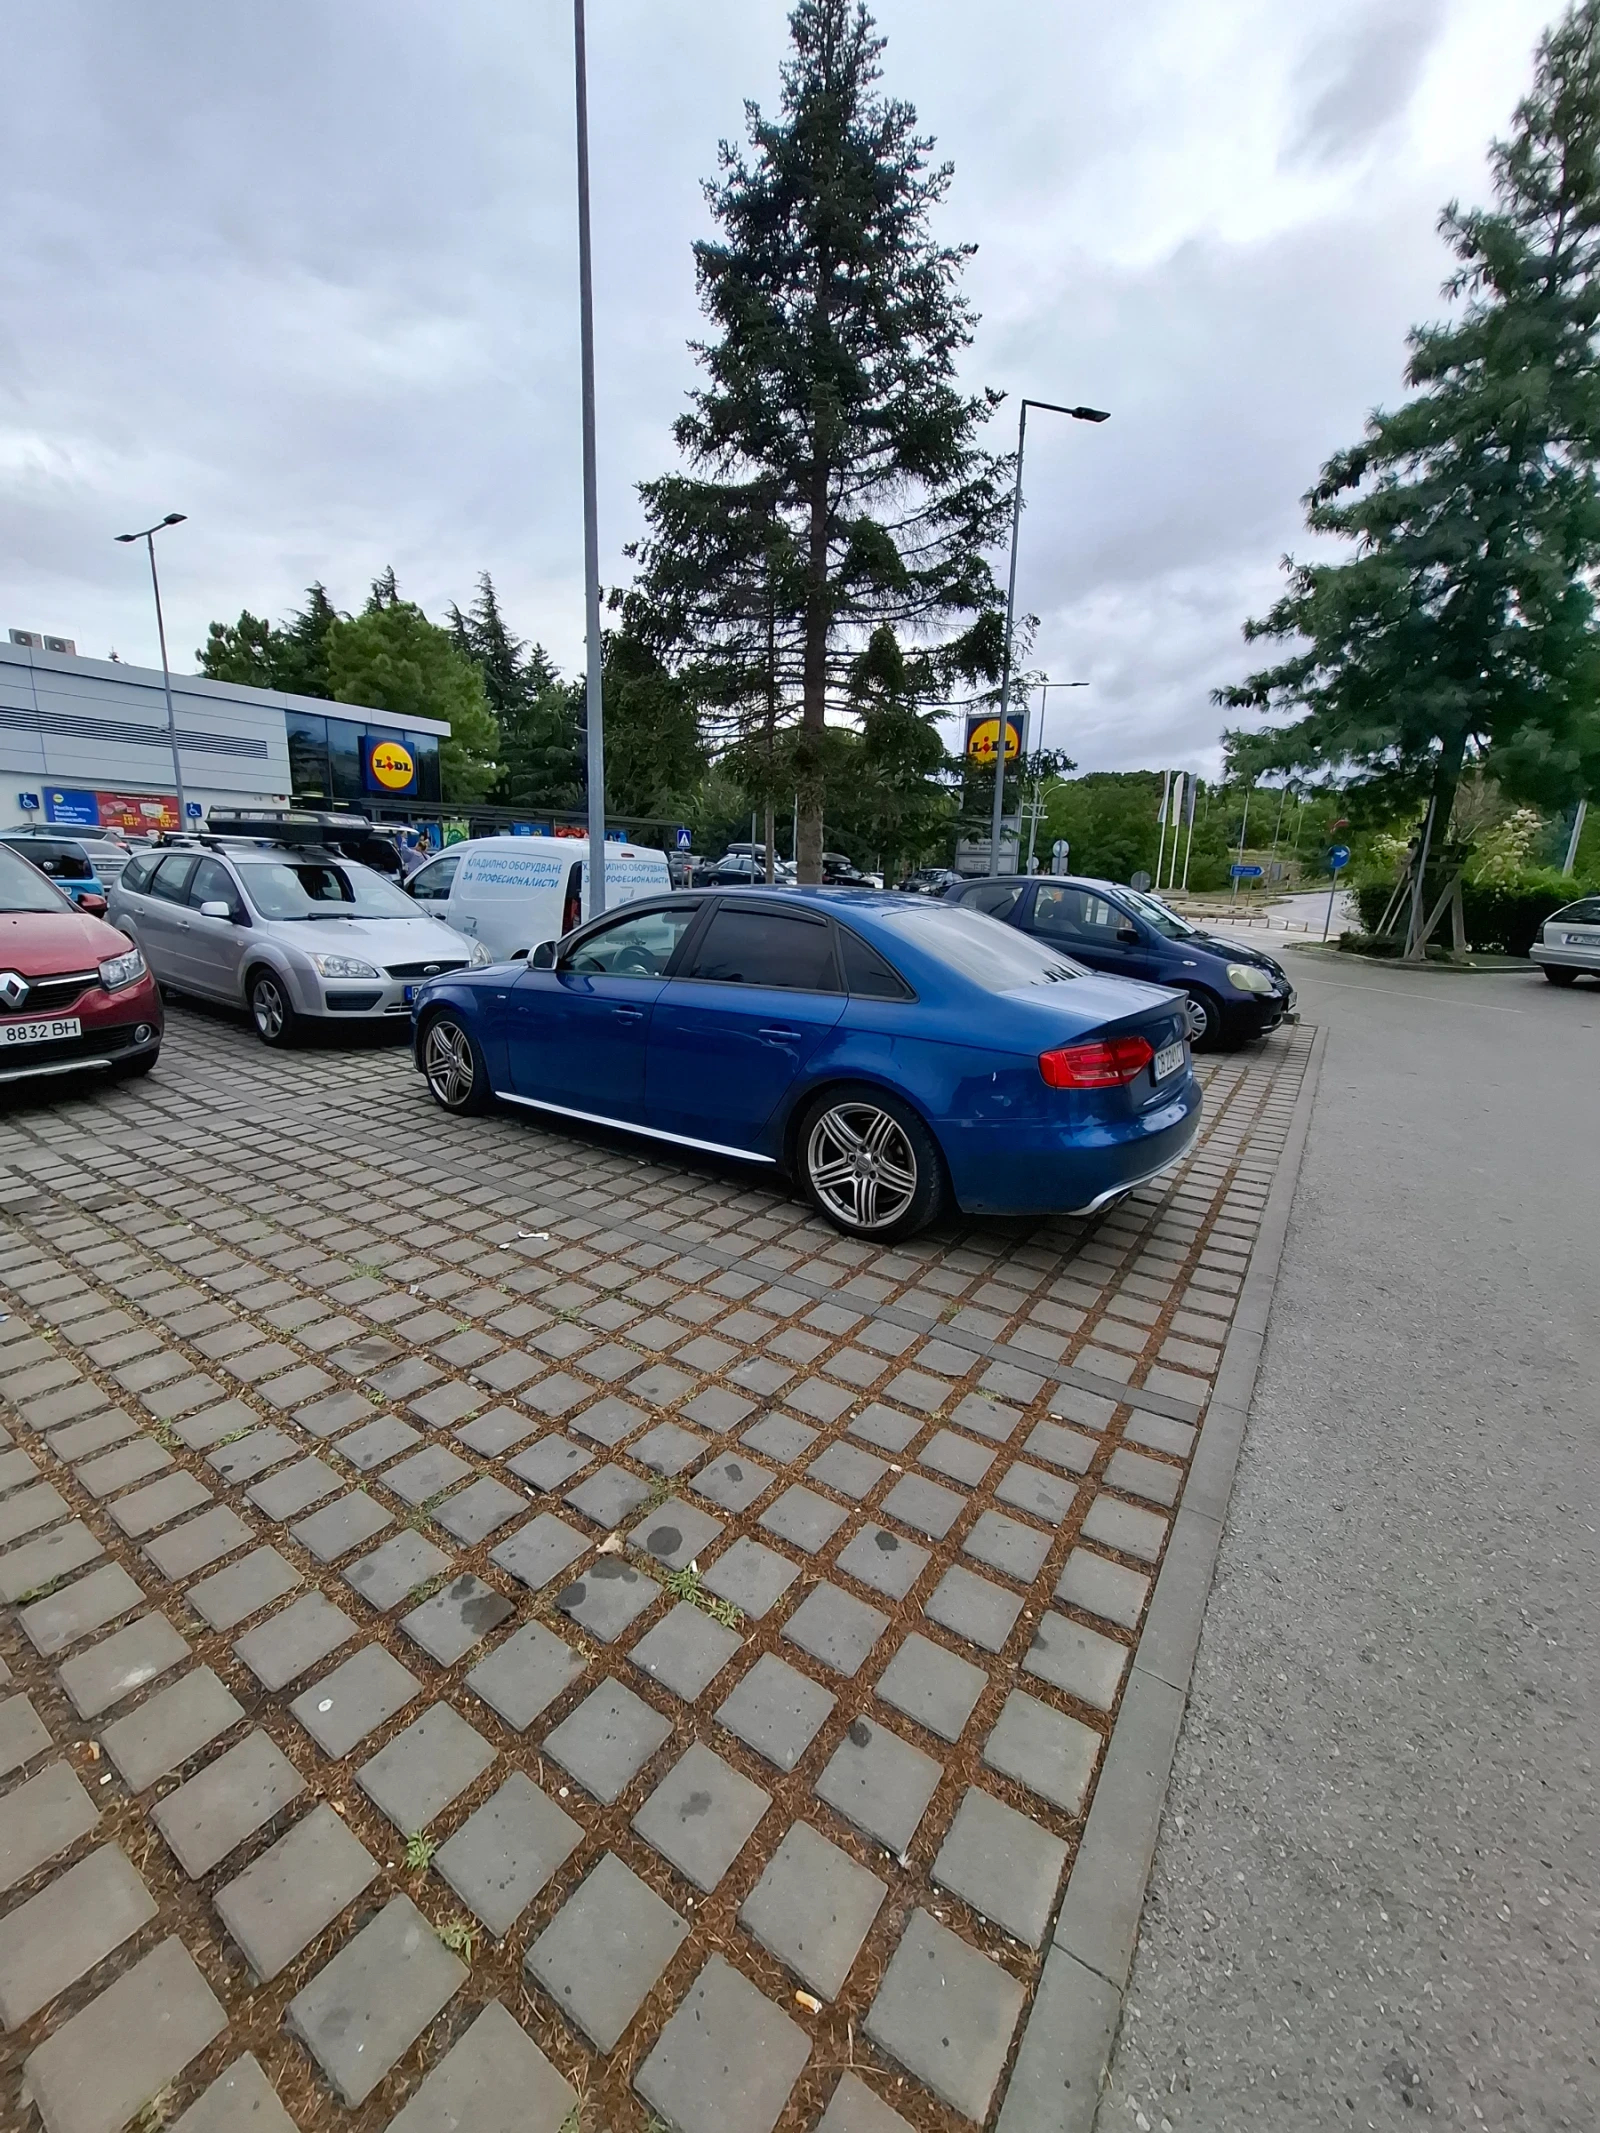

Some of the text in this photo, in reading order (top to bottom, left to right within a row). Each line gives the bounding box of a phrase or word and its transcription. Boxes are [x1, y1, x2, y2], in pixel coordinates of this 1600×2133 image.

[509, 860, 562, 874] ОБОРУДВАНЕ
[582, 863, 628, 873] ХИЛНО
[462, 871, 559, 888] ЗА ПРОФЕСИОНАЛИСТИ
[604, 875, 669, 885] РОФЕСИОНАЛИСТИ
[6, 1024, 49, 1041] 8832
